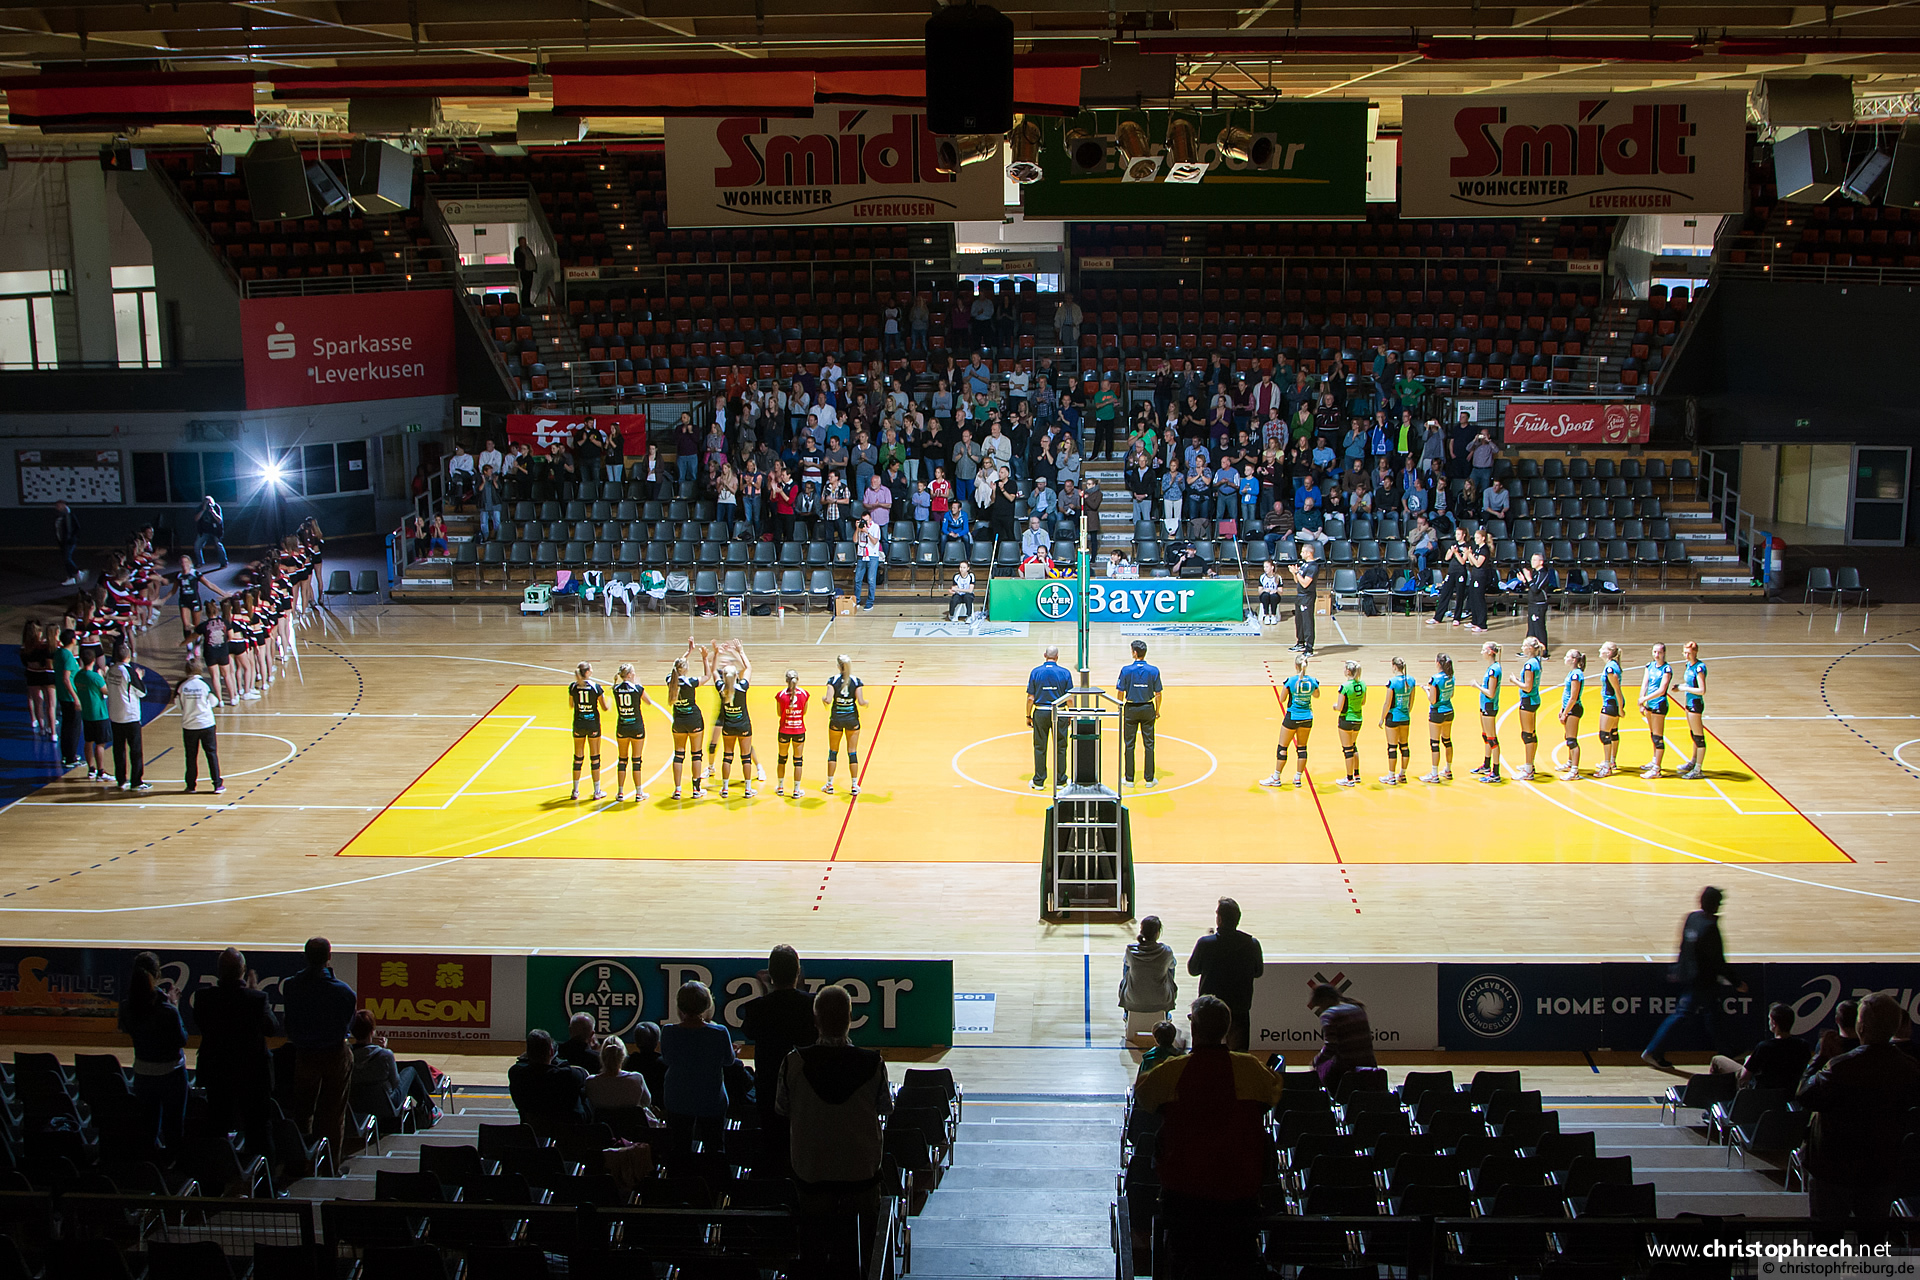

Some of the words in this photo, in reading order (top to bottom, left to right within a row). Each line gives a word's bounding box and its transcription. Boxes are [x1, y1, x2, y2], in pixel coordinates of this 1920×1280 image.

[1450, 100, 1697, 177] Smidt
[723, 190, 832, 206] WOHNCENTER
[1458, 181, 1568, 196] WOHNCENTER
[853, 203, 935, 217] LEVERKUSEN
[1589, 195, 1672, 208] LEVERKUSEN
[312, 334, 413, 360] Sparkasse
[314, 361, 425, 383] Leverkusen
[1512, 413, 1550, 434] Früh
[1550, 414, 1594, 436] Sport
[1088, 584, 1194, 613] Bayer
[578, 690, 590, 703] 11
[618, 694, 632, 706] 10
[47, 974, 115, 995] HILLE
[1466, 982, 1513, 1002] VOLLEYBALL
[572, 993, 638, 1006] BAYER
[598, 966, 611, 1033] BAYER
[1536, 997, 1604, 1015] HOME
[1611, 996, 1639, 1014] OF
[365, 997, 486, 1022] MASON
[1468, 1012, 1513, 1030] BUNDESLIGA
